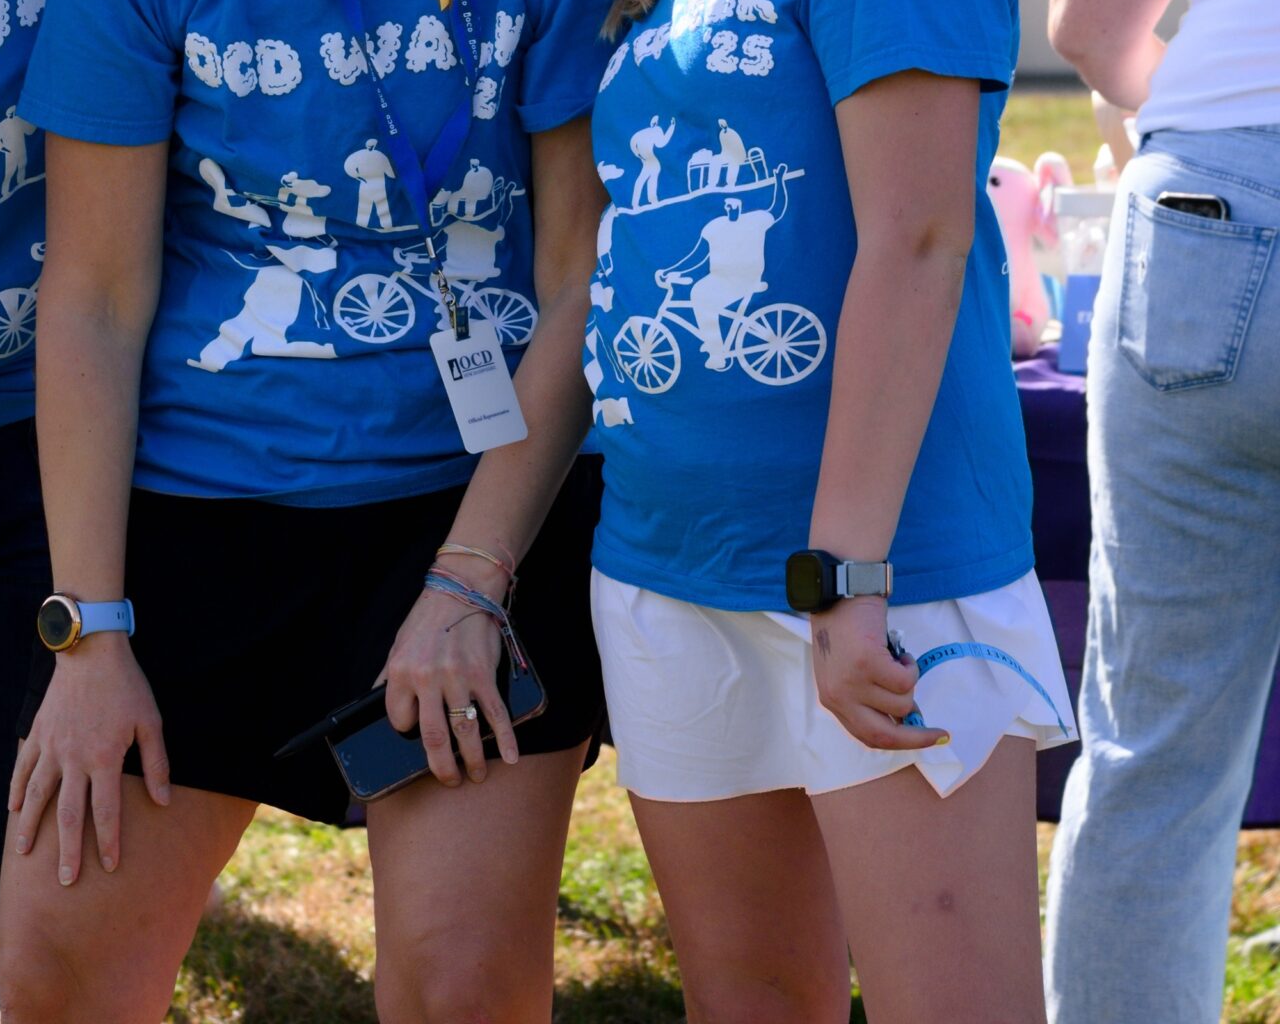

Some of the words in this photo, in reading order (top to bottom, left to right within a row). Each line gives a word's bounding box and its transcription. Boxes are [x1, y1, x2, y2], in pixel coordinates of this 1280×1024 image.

[185, 32, 302, 97] OCD
[460, 350, 493, 370] OCD
[920, 647, 957, 669] TICKE
